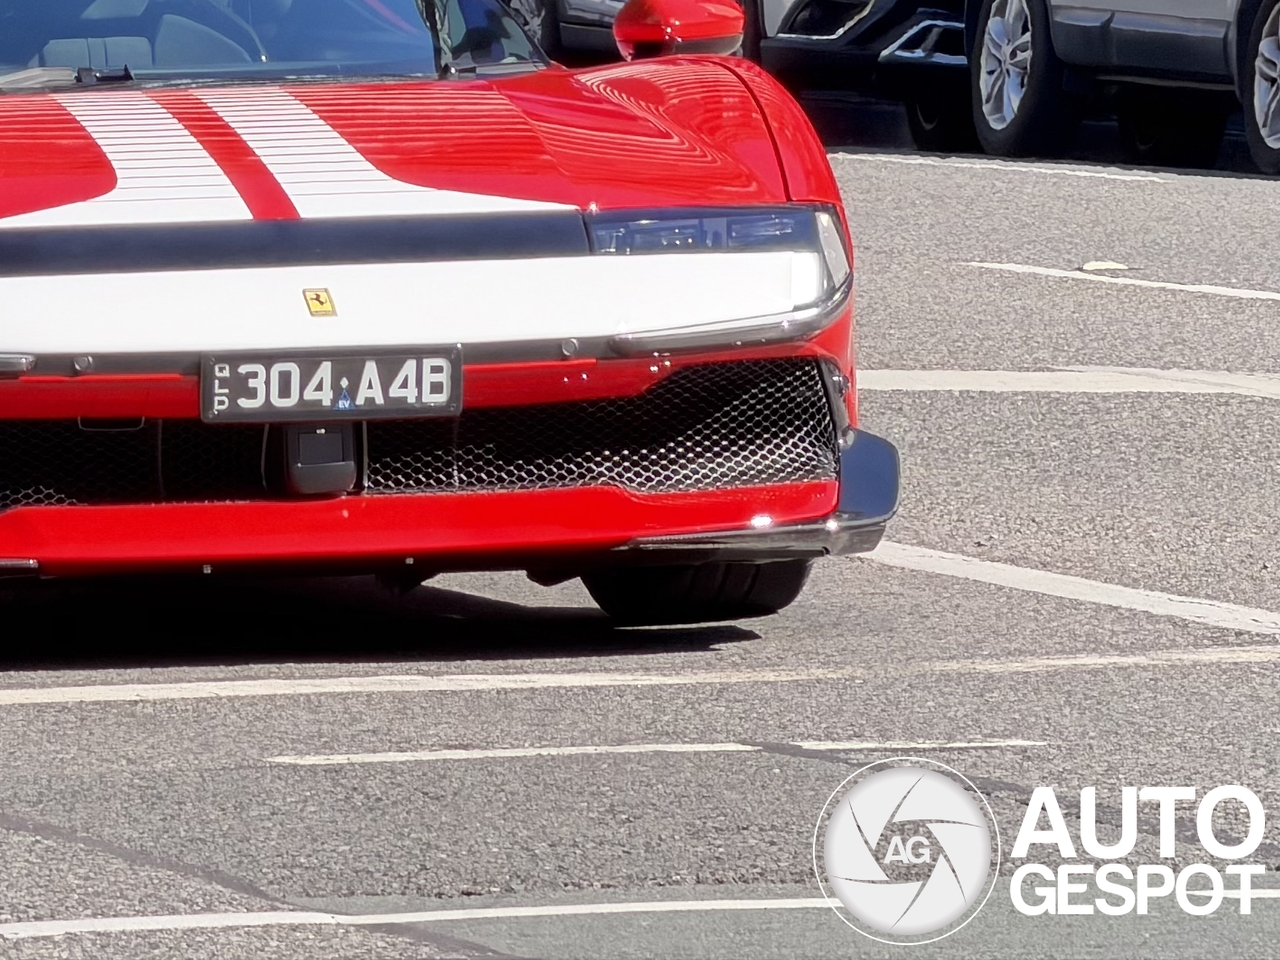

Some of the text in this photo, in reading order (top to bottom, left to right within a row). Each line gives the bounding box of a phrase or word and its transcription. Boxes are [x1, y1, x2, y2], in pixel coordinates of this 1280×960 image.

[214, 362, 230, 410] QLD
[237, 358, 452, 408] 304 A4B
[338, 400, 350, 409] EV
